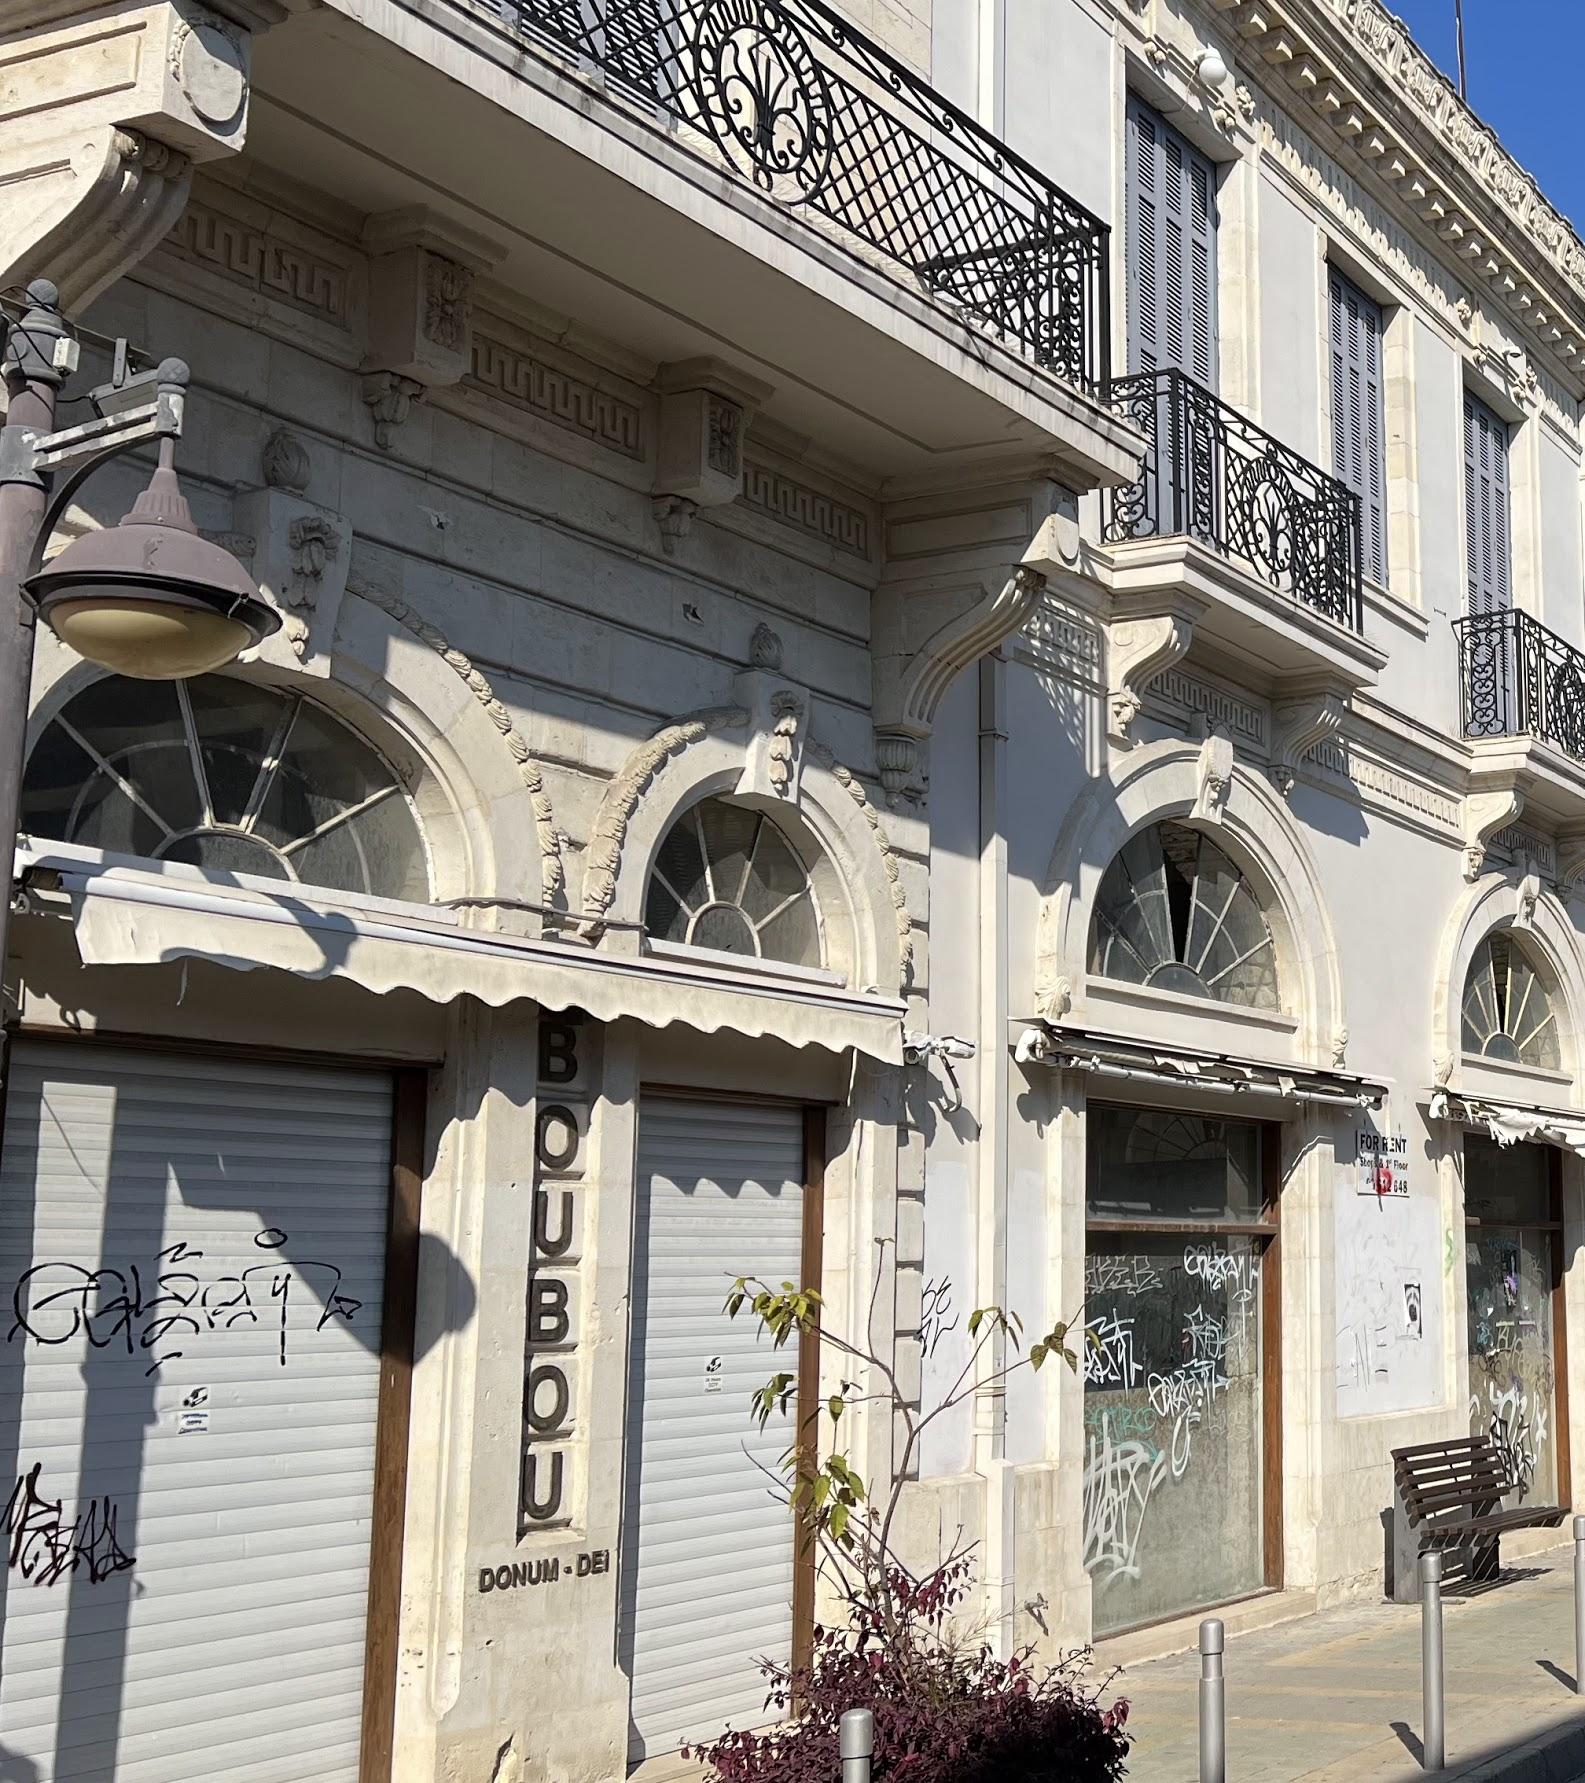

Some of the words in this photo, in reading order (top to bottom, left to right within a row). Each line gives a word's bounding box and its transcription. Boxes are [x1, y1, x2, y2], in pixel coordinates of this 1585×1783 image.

[1360, 1134, 1379, 1151] FOR
[1382, 1136, 1407, 1153] RENT
[1394, 1160, 1408, 1171] Floor
[521, 1021, 579, 1519] BOUBOU
[478, 1557, 560, 1594] DONUM
